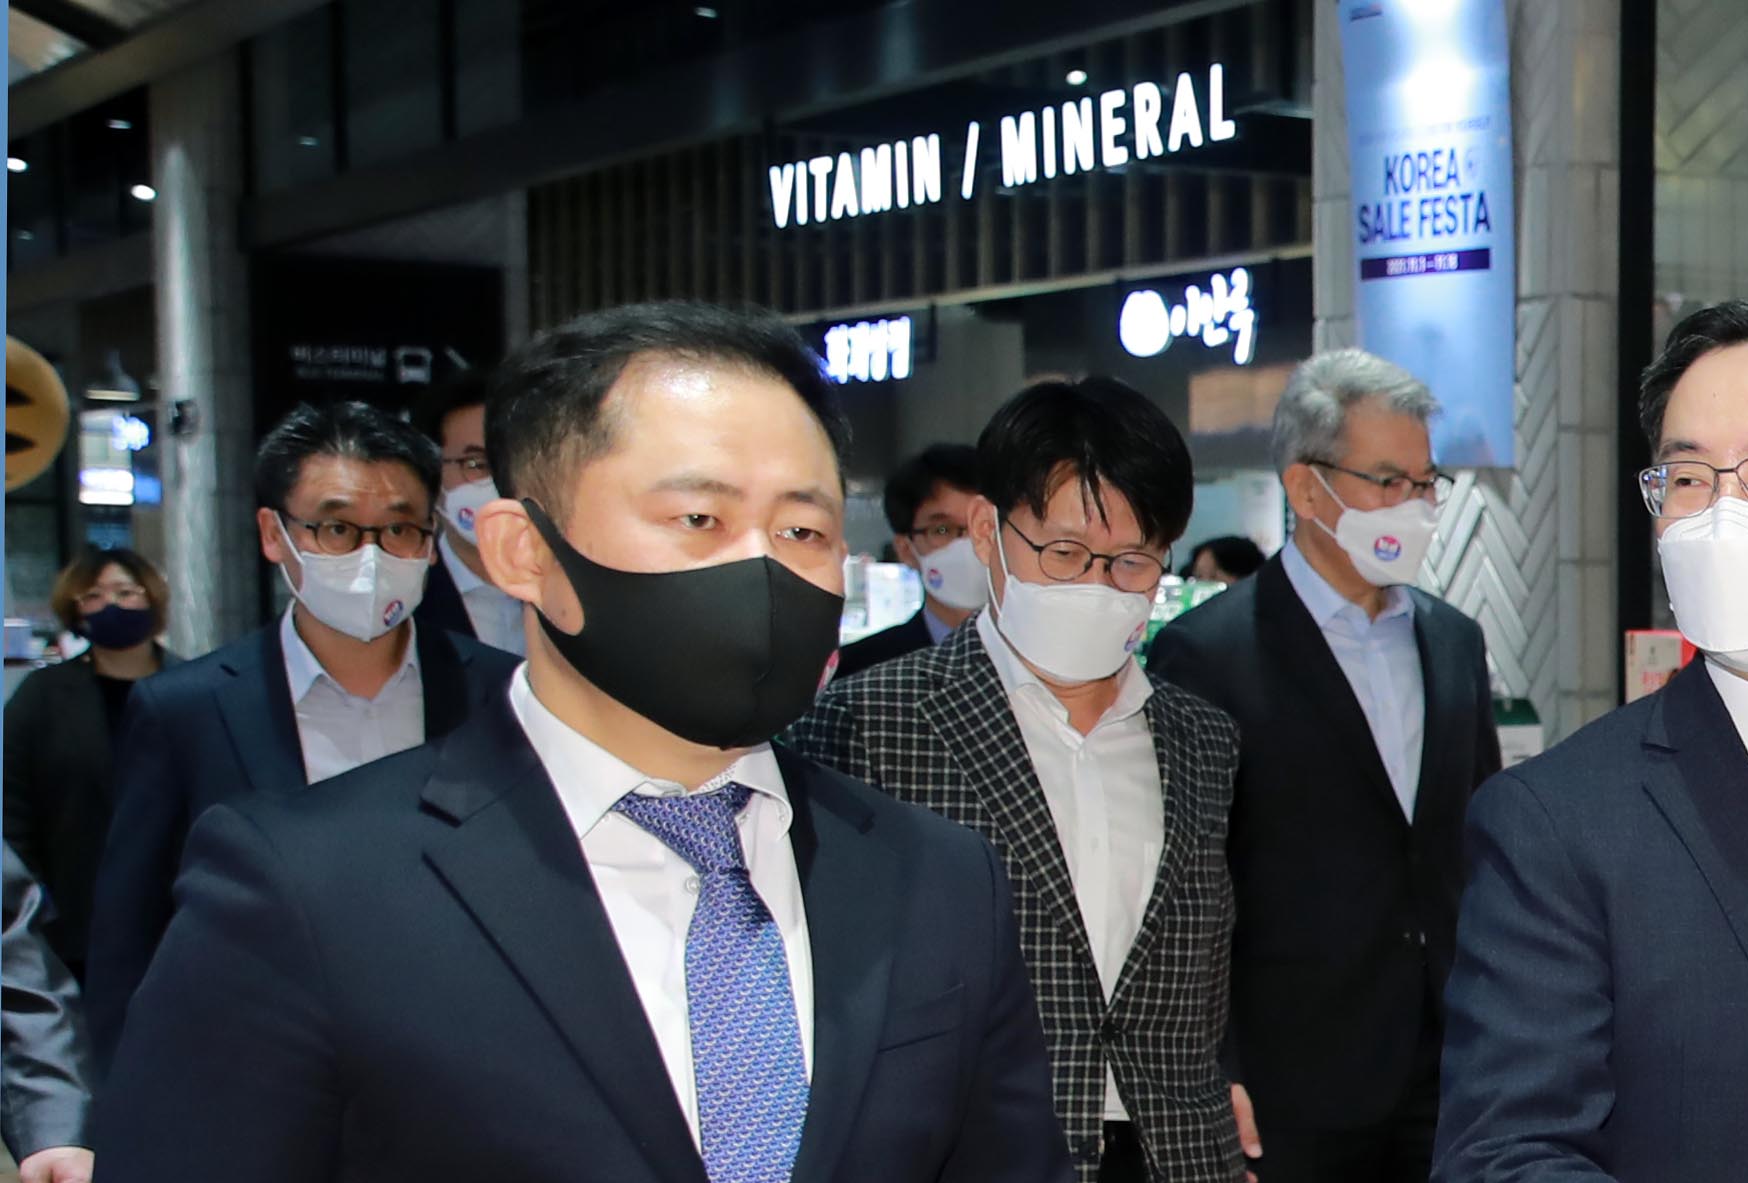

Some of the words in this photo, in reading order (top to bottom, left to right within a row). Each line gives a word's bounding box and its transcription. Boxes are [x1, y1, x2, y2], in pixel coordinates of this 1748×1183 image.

[769, 133, 941, 229] VITAMIN
[961, 121, 980, 200] /
[1001, 63, 1236, 188] MINERAL
[1383, 148, 1461, 196] KOREA
[1358, 200, 1411, 245] SALE
[1418, 189, 1491, 238] FESTA
